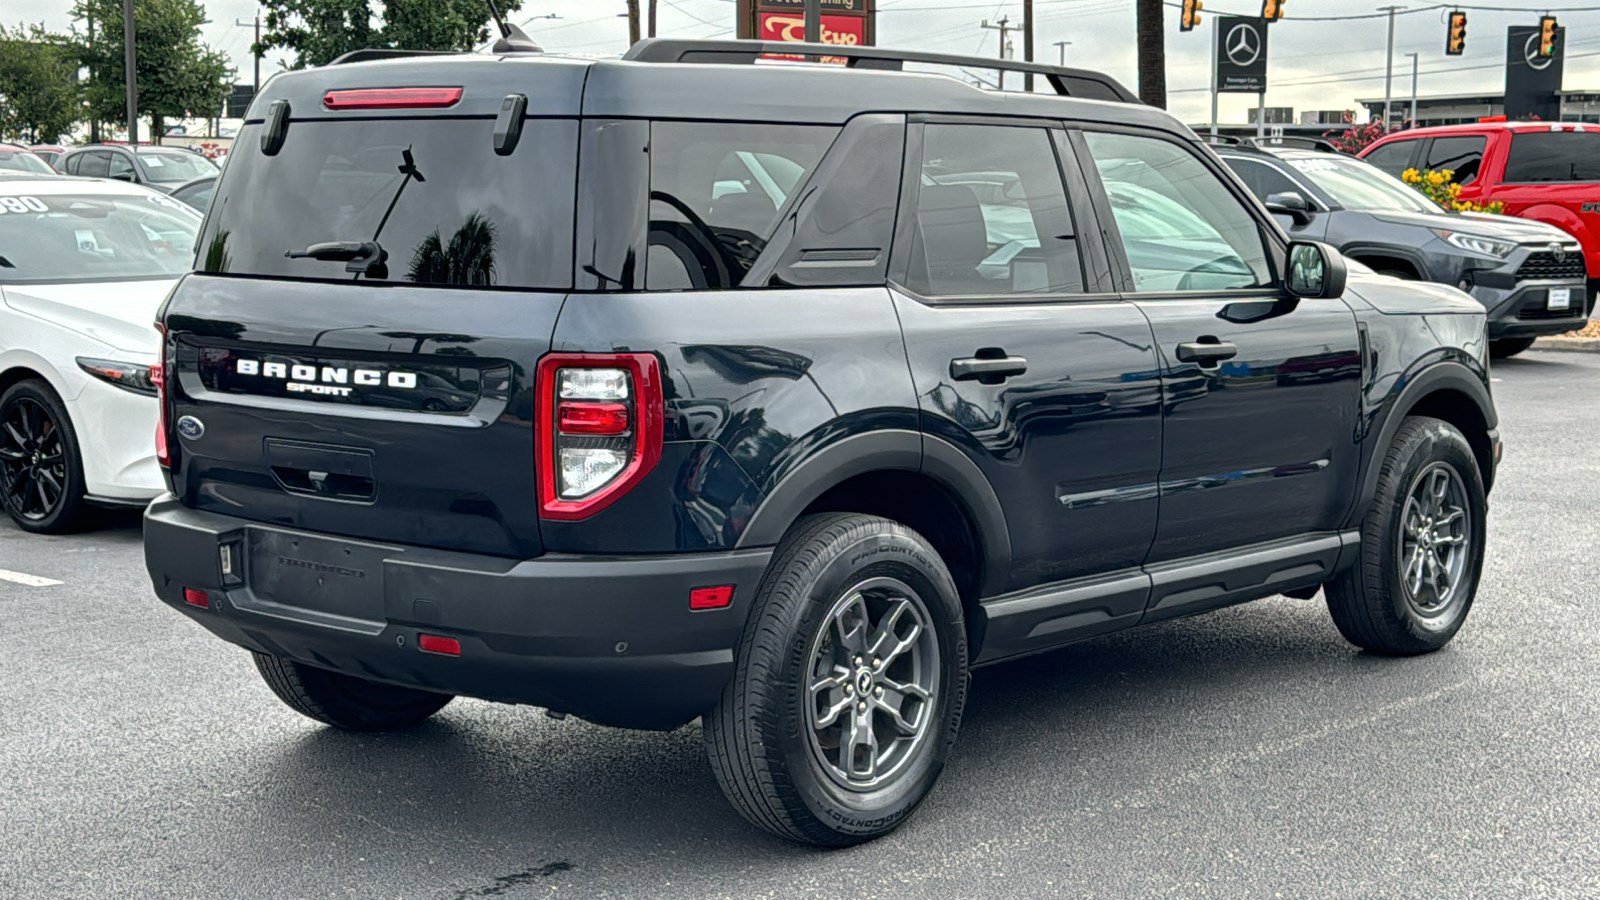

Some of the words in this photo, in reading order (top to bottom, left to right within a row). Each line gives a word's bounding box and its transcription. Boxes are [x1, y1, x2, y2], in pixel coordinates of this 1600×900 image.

[765, 16, 858, 46] Tkyo
[236, 358, 417, 389] BRONCO
[286, 381, 353, 397] SPORT
[279, 555, 366, 578] BRONCO
